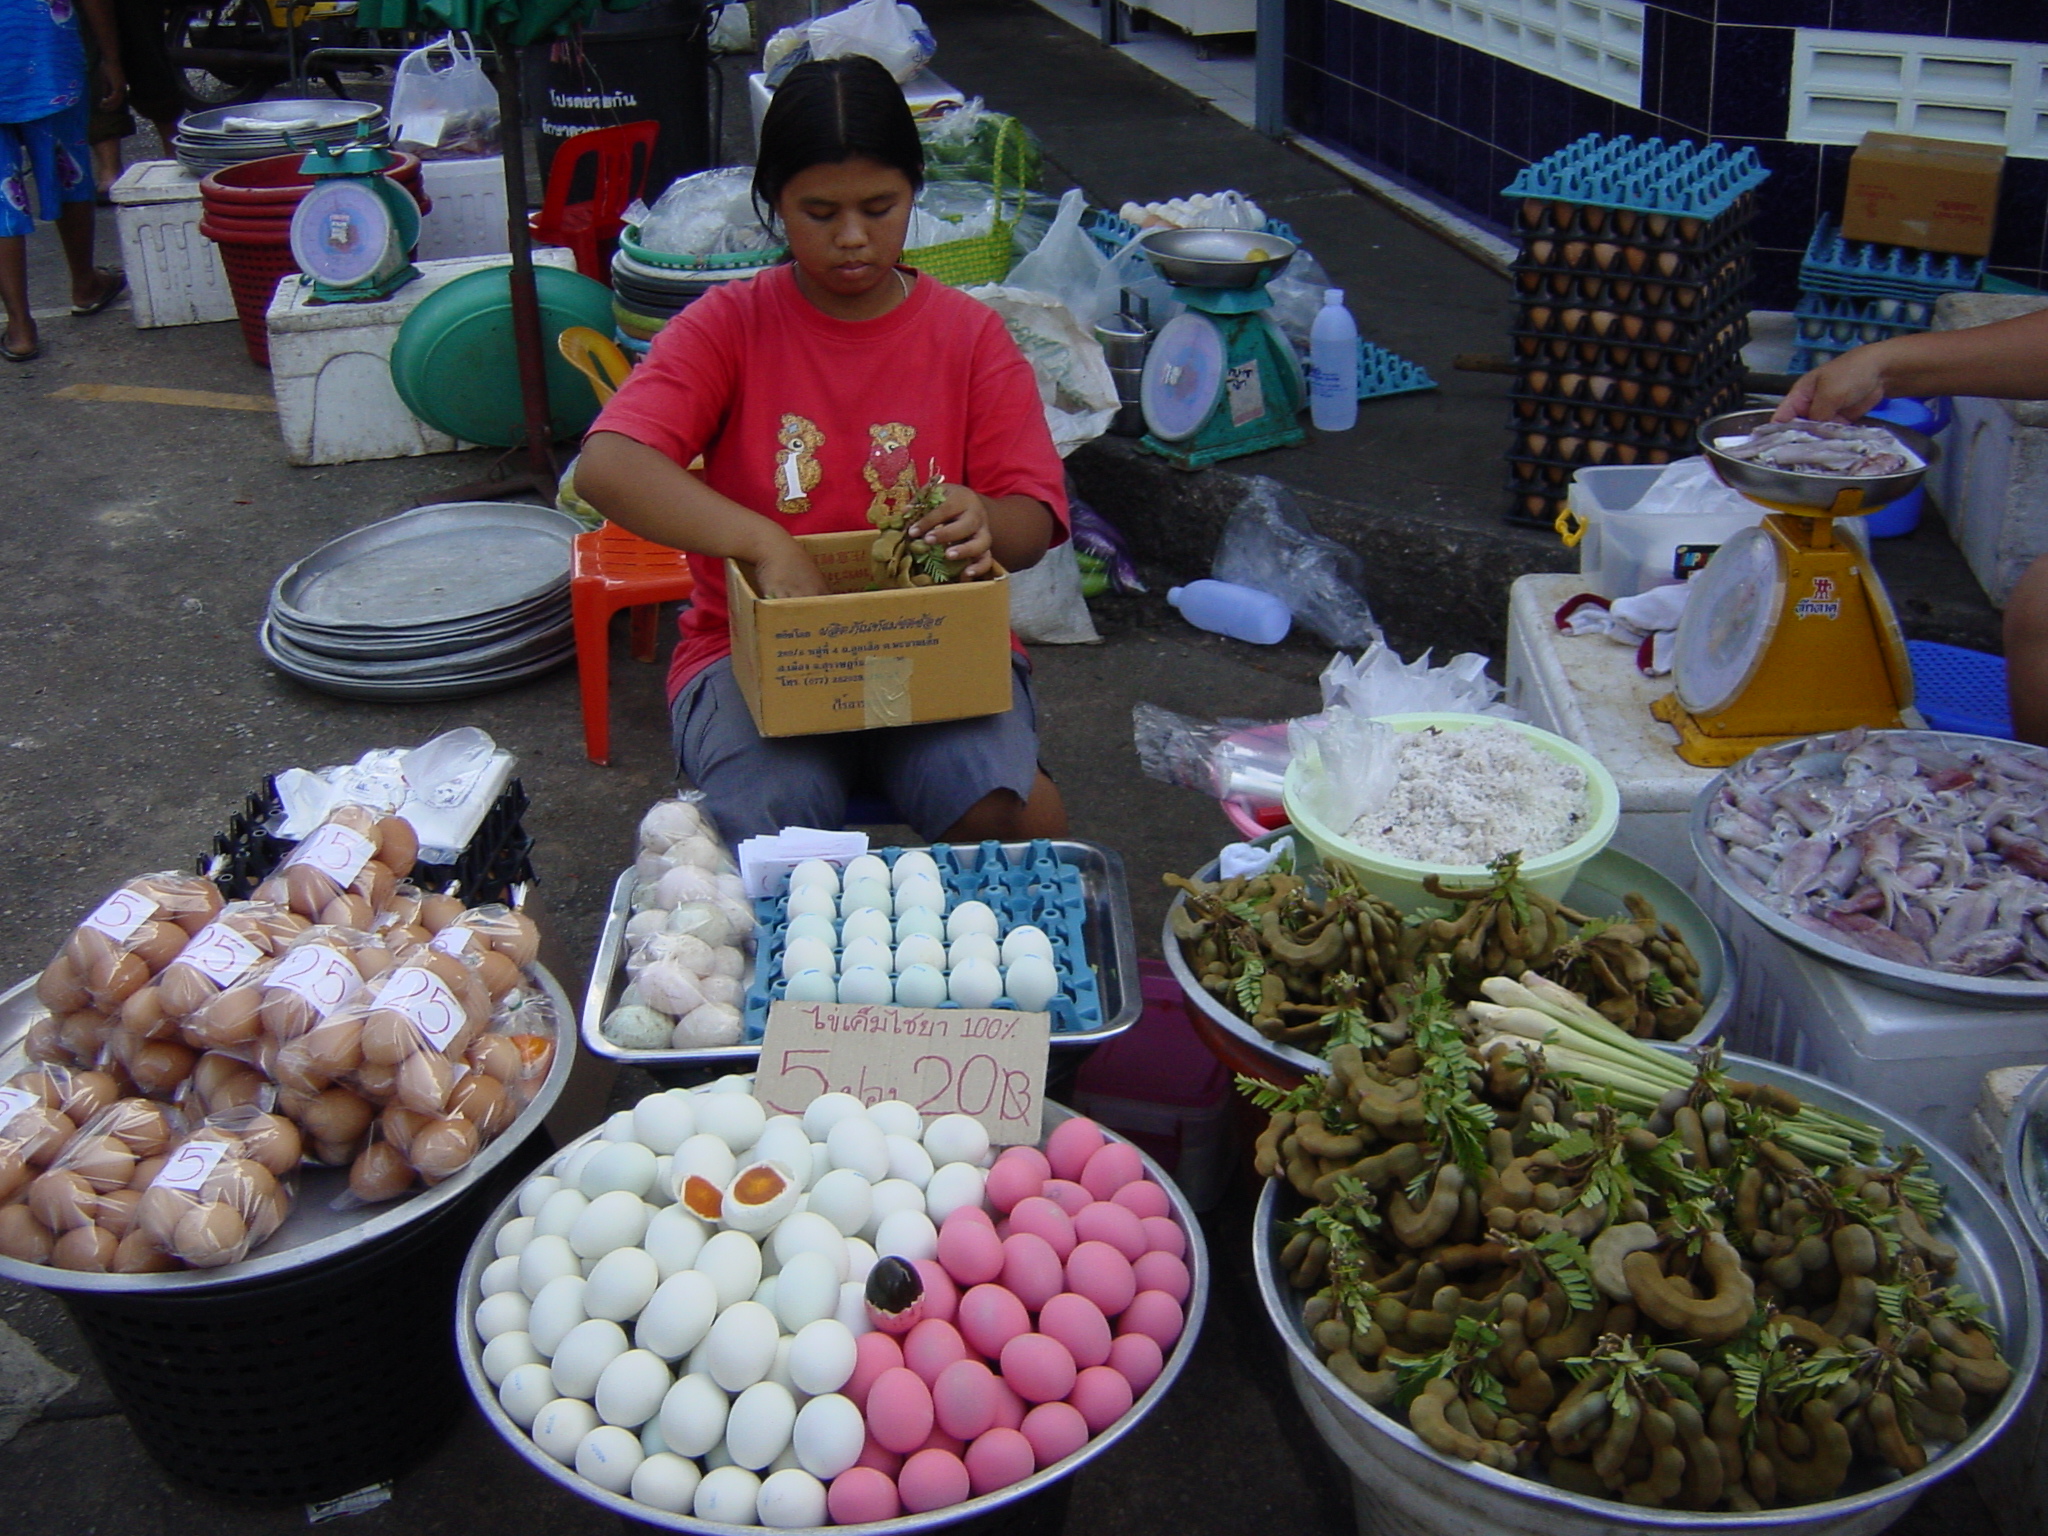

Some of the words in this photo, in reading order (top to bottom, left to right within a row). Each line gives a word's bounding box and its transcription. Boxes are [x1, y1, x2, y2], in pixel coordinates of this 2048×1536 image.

[278, 948, 354, 1005] 25
[384, 969, 457, 1035] 25
[802, 1004, 948, 1037] ไข่เค็มไชยา
[960, 1016, 1021, 1040] 100%
[766, 1050, 831, 1115] 5
